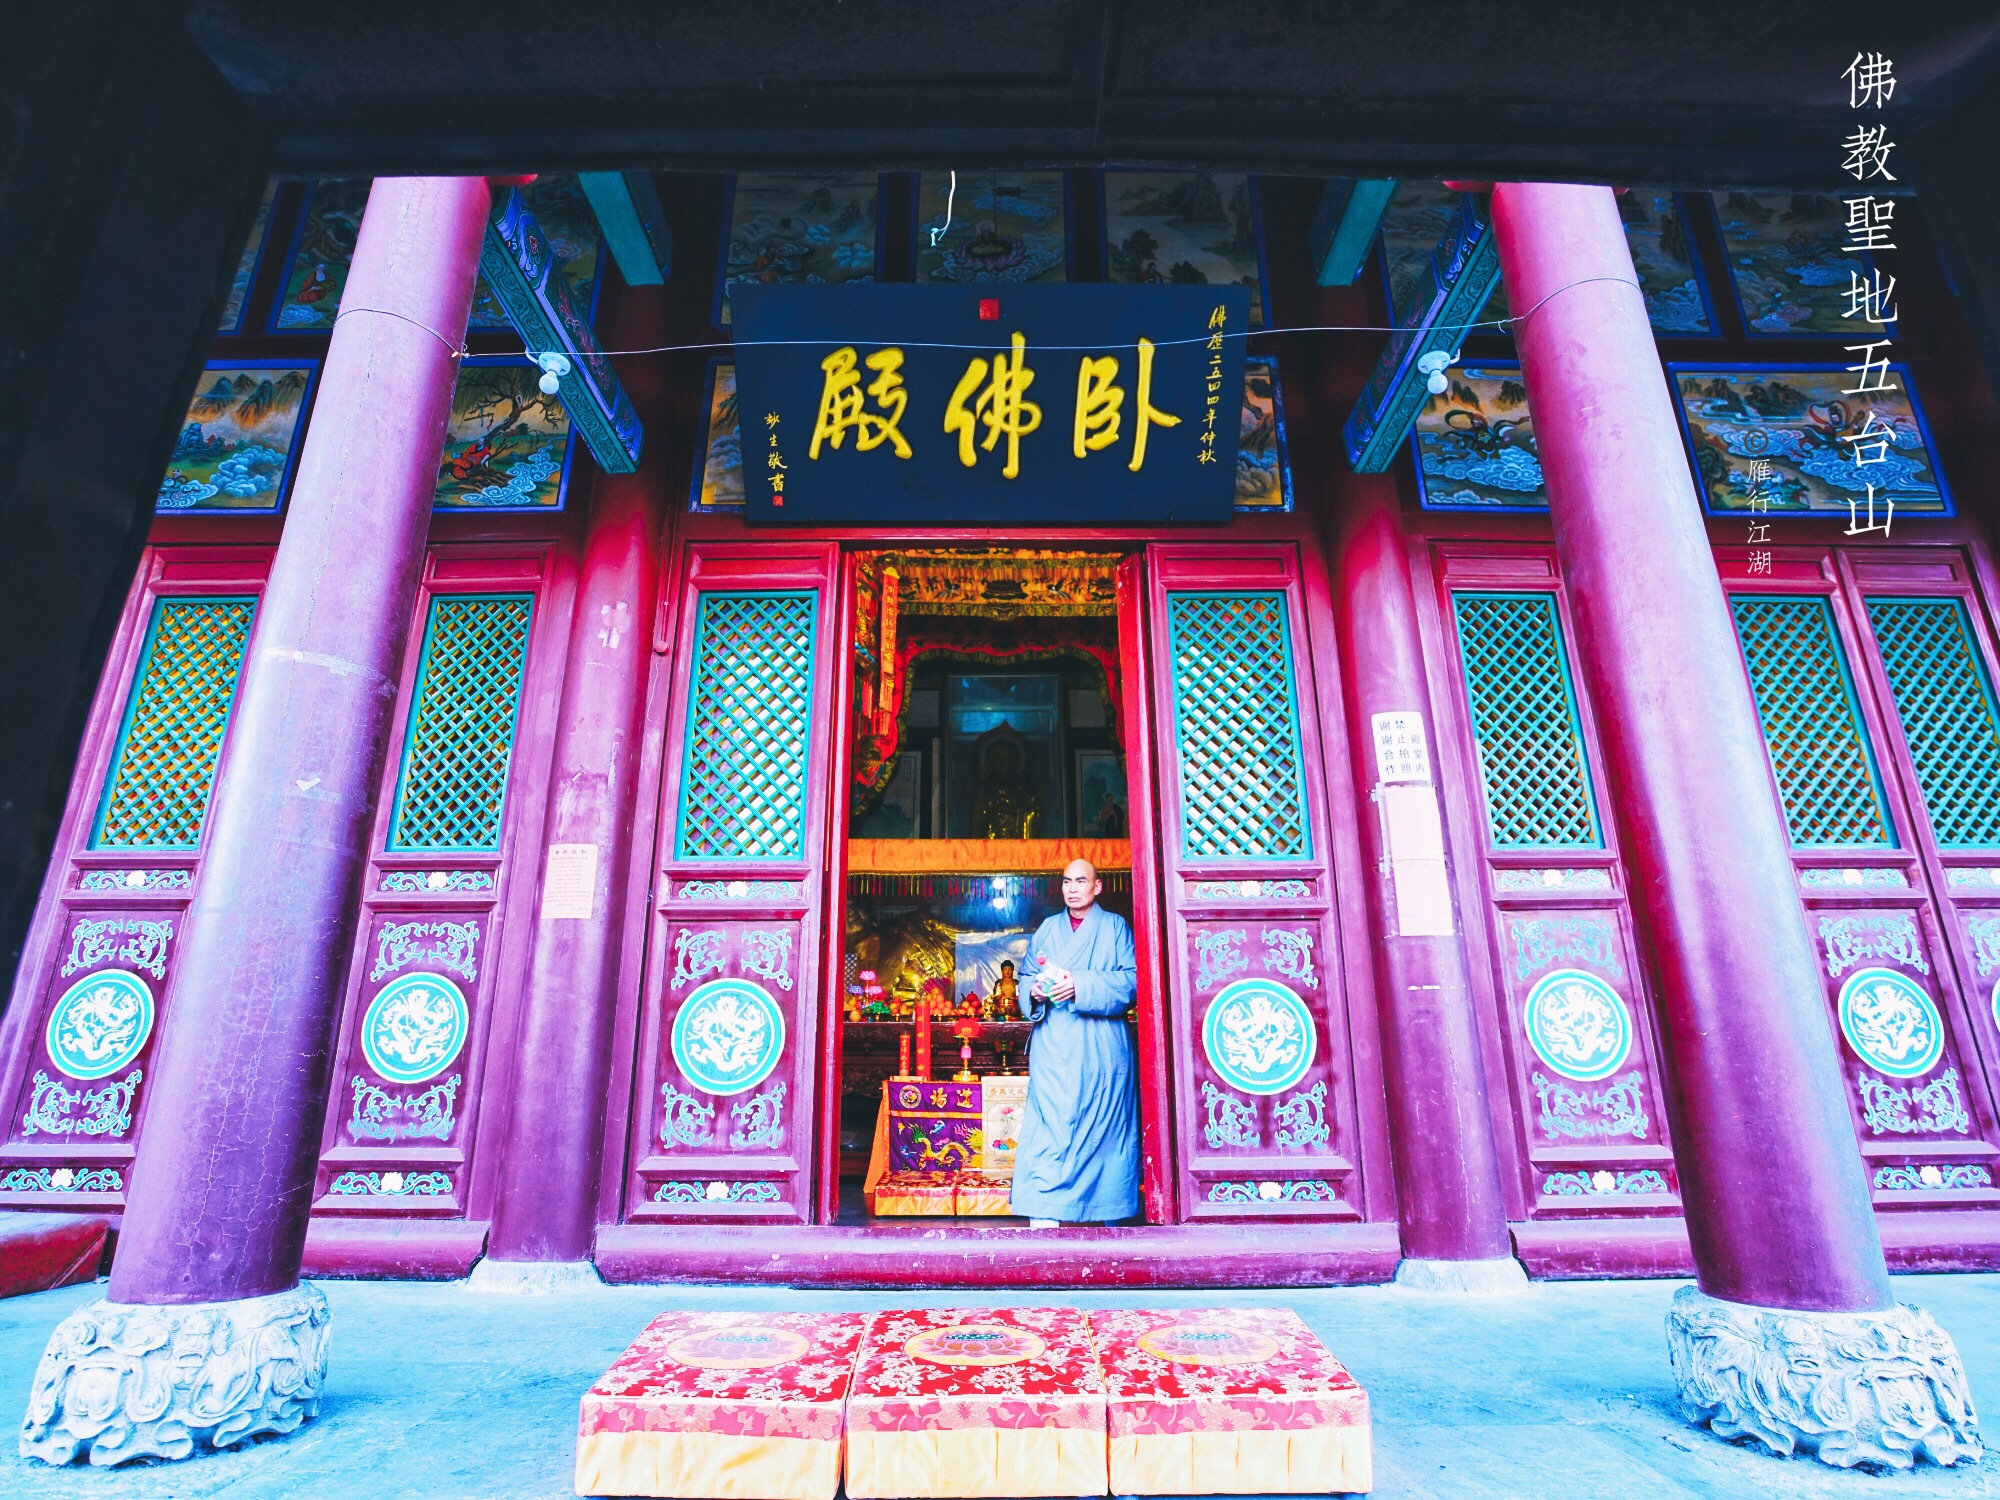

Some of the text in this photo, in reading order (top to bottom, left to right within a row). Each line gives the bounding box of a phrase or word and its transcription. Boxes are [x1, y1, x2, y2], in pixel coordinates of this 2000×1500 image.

[1379, 721, 1396, 775] 谢谢合作
[1395, 720, 1412, 773] 禁止拍照
